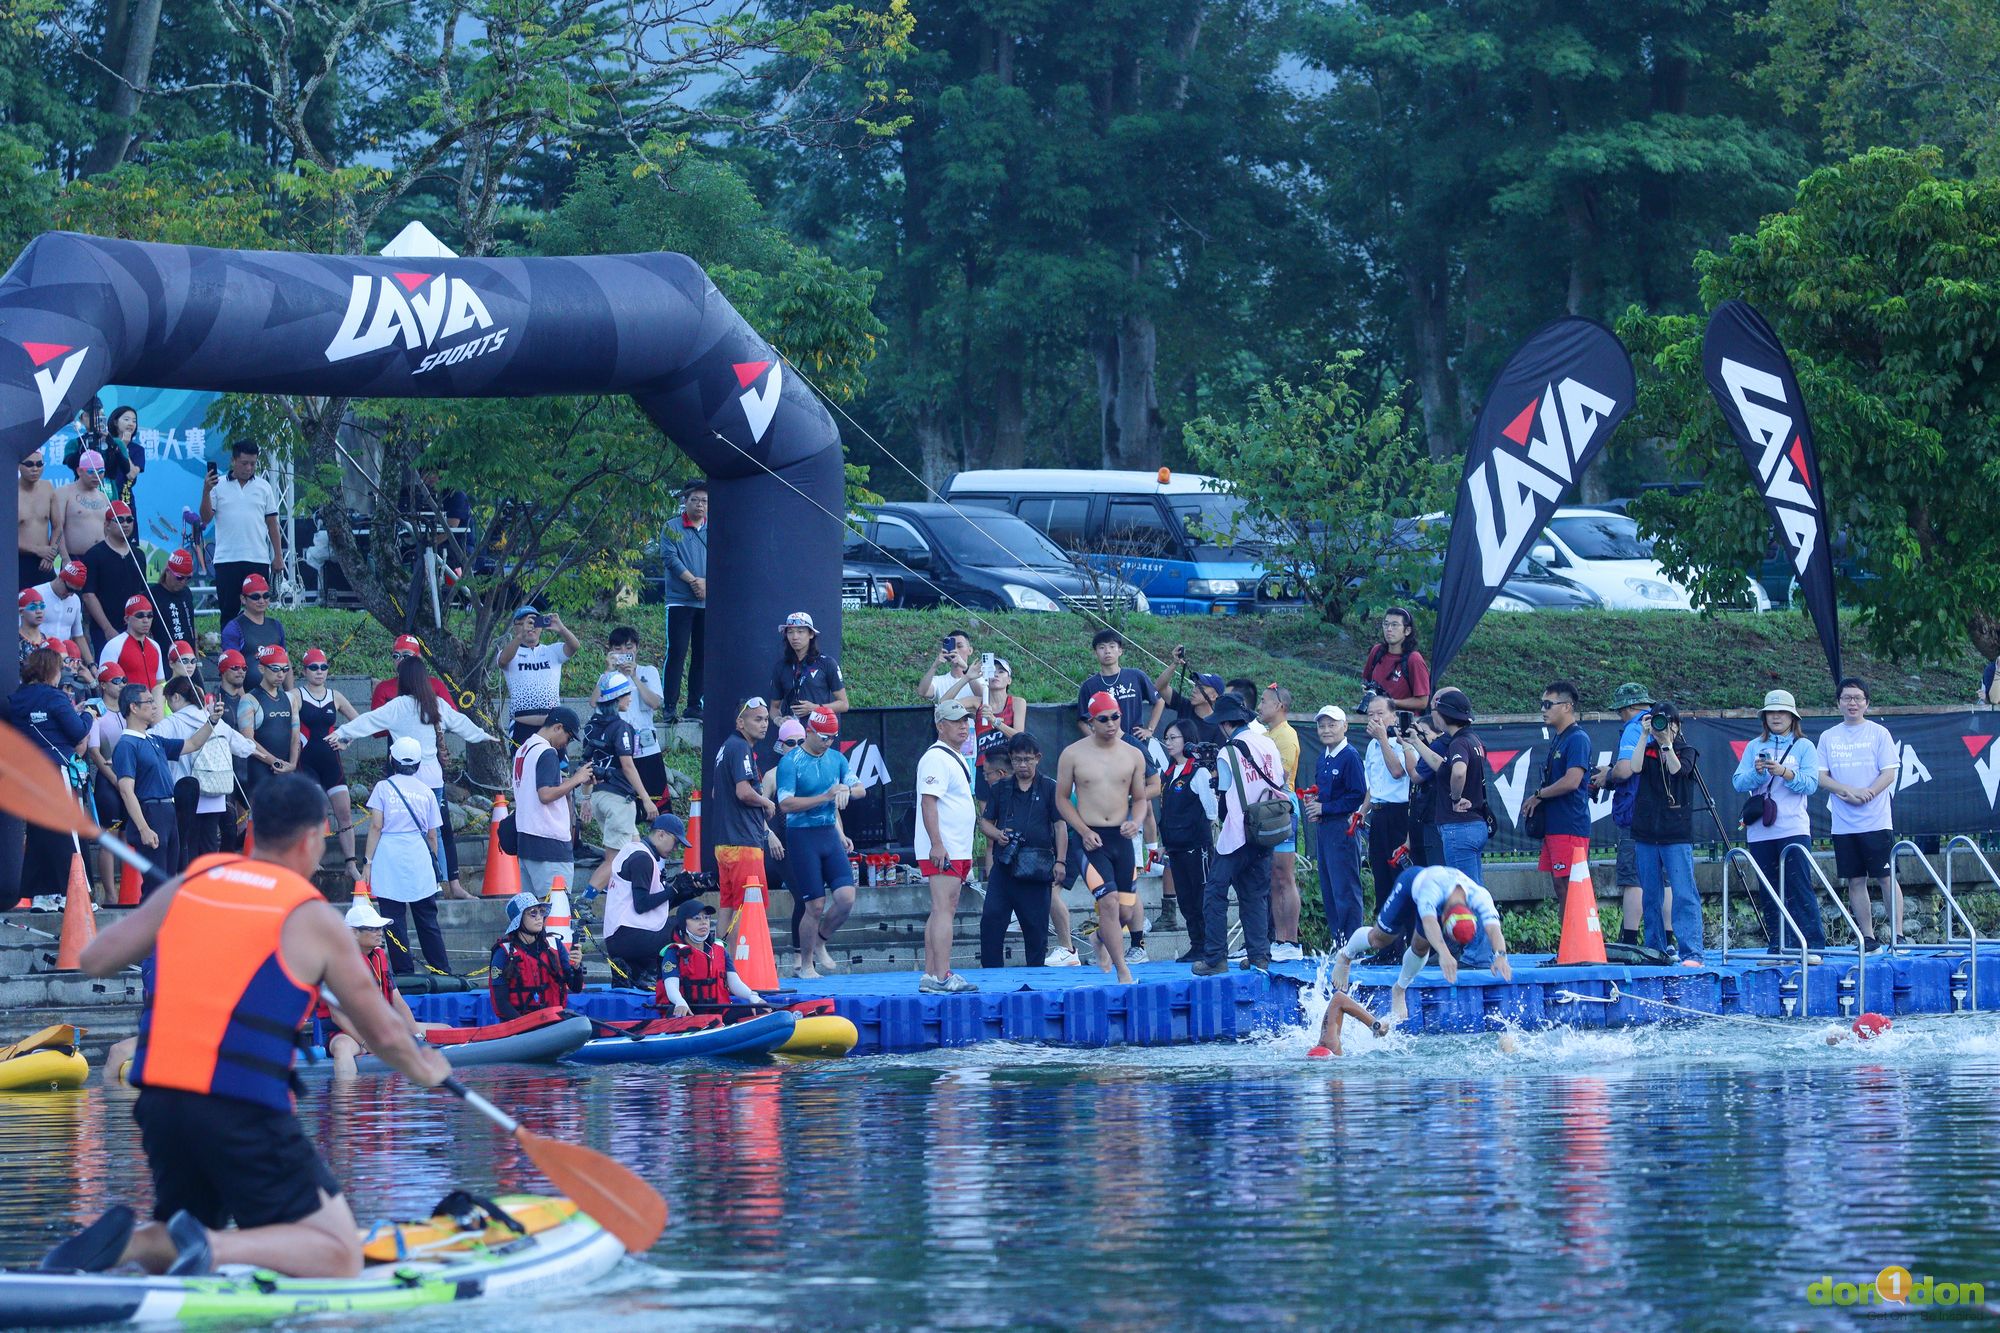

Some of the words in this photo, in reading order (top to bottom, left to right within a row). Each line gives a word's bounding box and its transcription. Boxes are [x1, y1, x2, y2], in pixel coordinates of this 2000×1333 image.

[324, 272, 494, 363] LAVA
[411, 327, 509, 375] SPORTS
[1467, 377, 1616, 587] LAVA
[1721, 357, 1818, 577] LAVA
[517, 660, 551, 671] THULE
